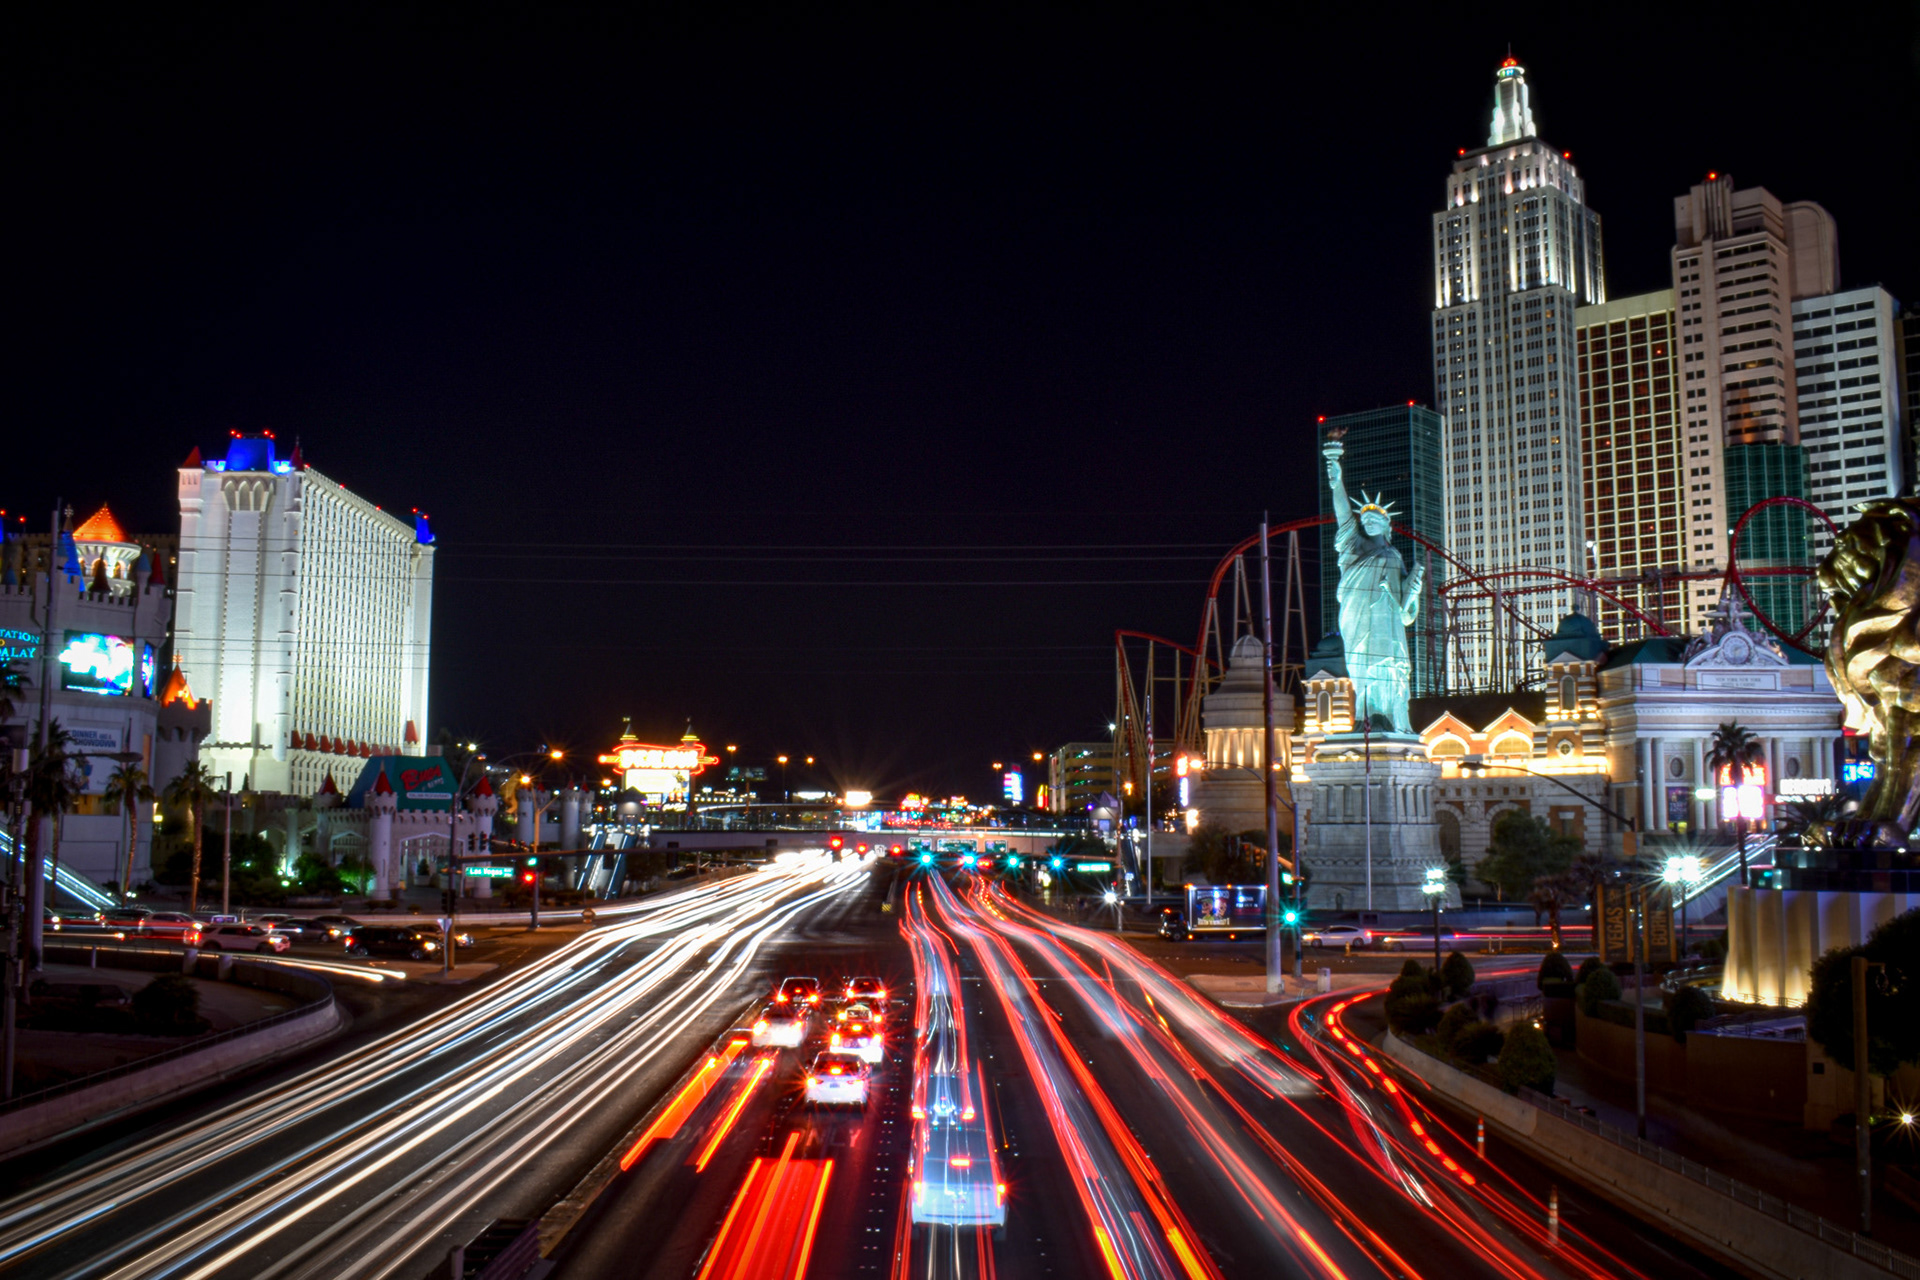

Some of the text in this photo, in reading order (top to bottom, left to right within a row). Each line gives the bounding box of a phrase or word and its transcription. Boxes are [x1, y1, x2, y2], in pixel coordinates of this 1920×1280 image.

[0, 646, 36, 658] ALAY
[72, 729, 98, 739] DINNER
[469, 867, 482, 875] Las
[483, 867, 503, 878] Vegas
[1606, 907, 1625, 950] VEGAS
